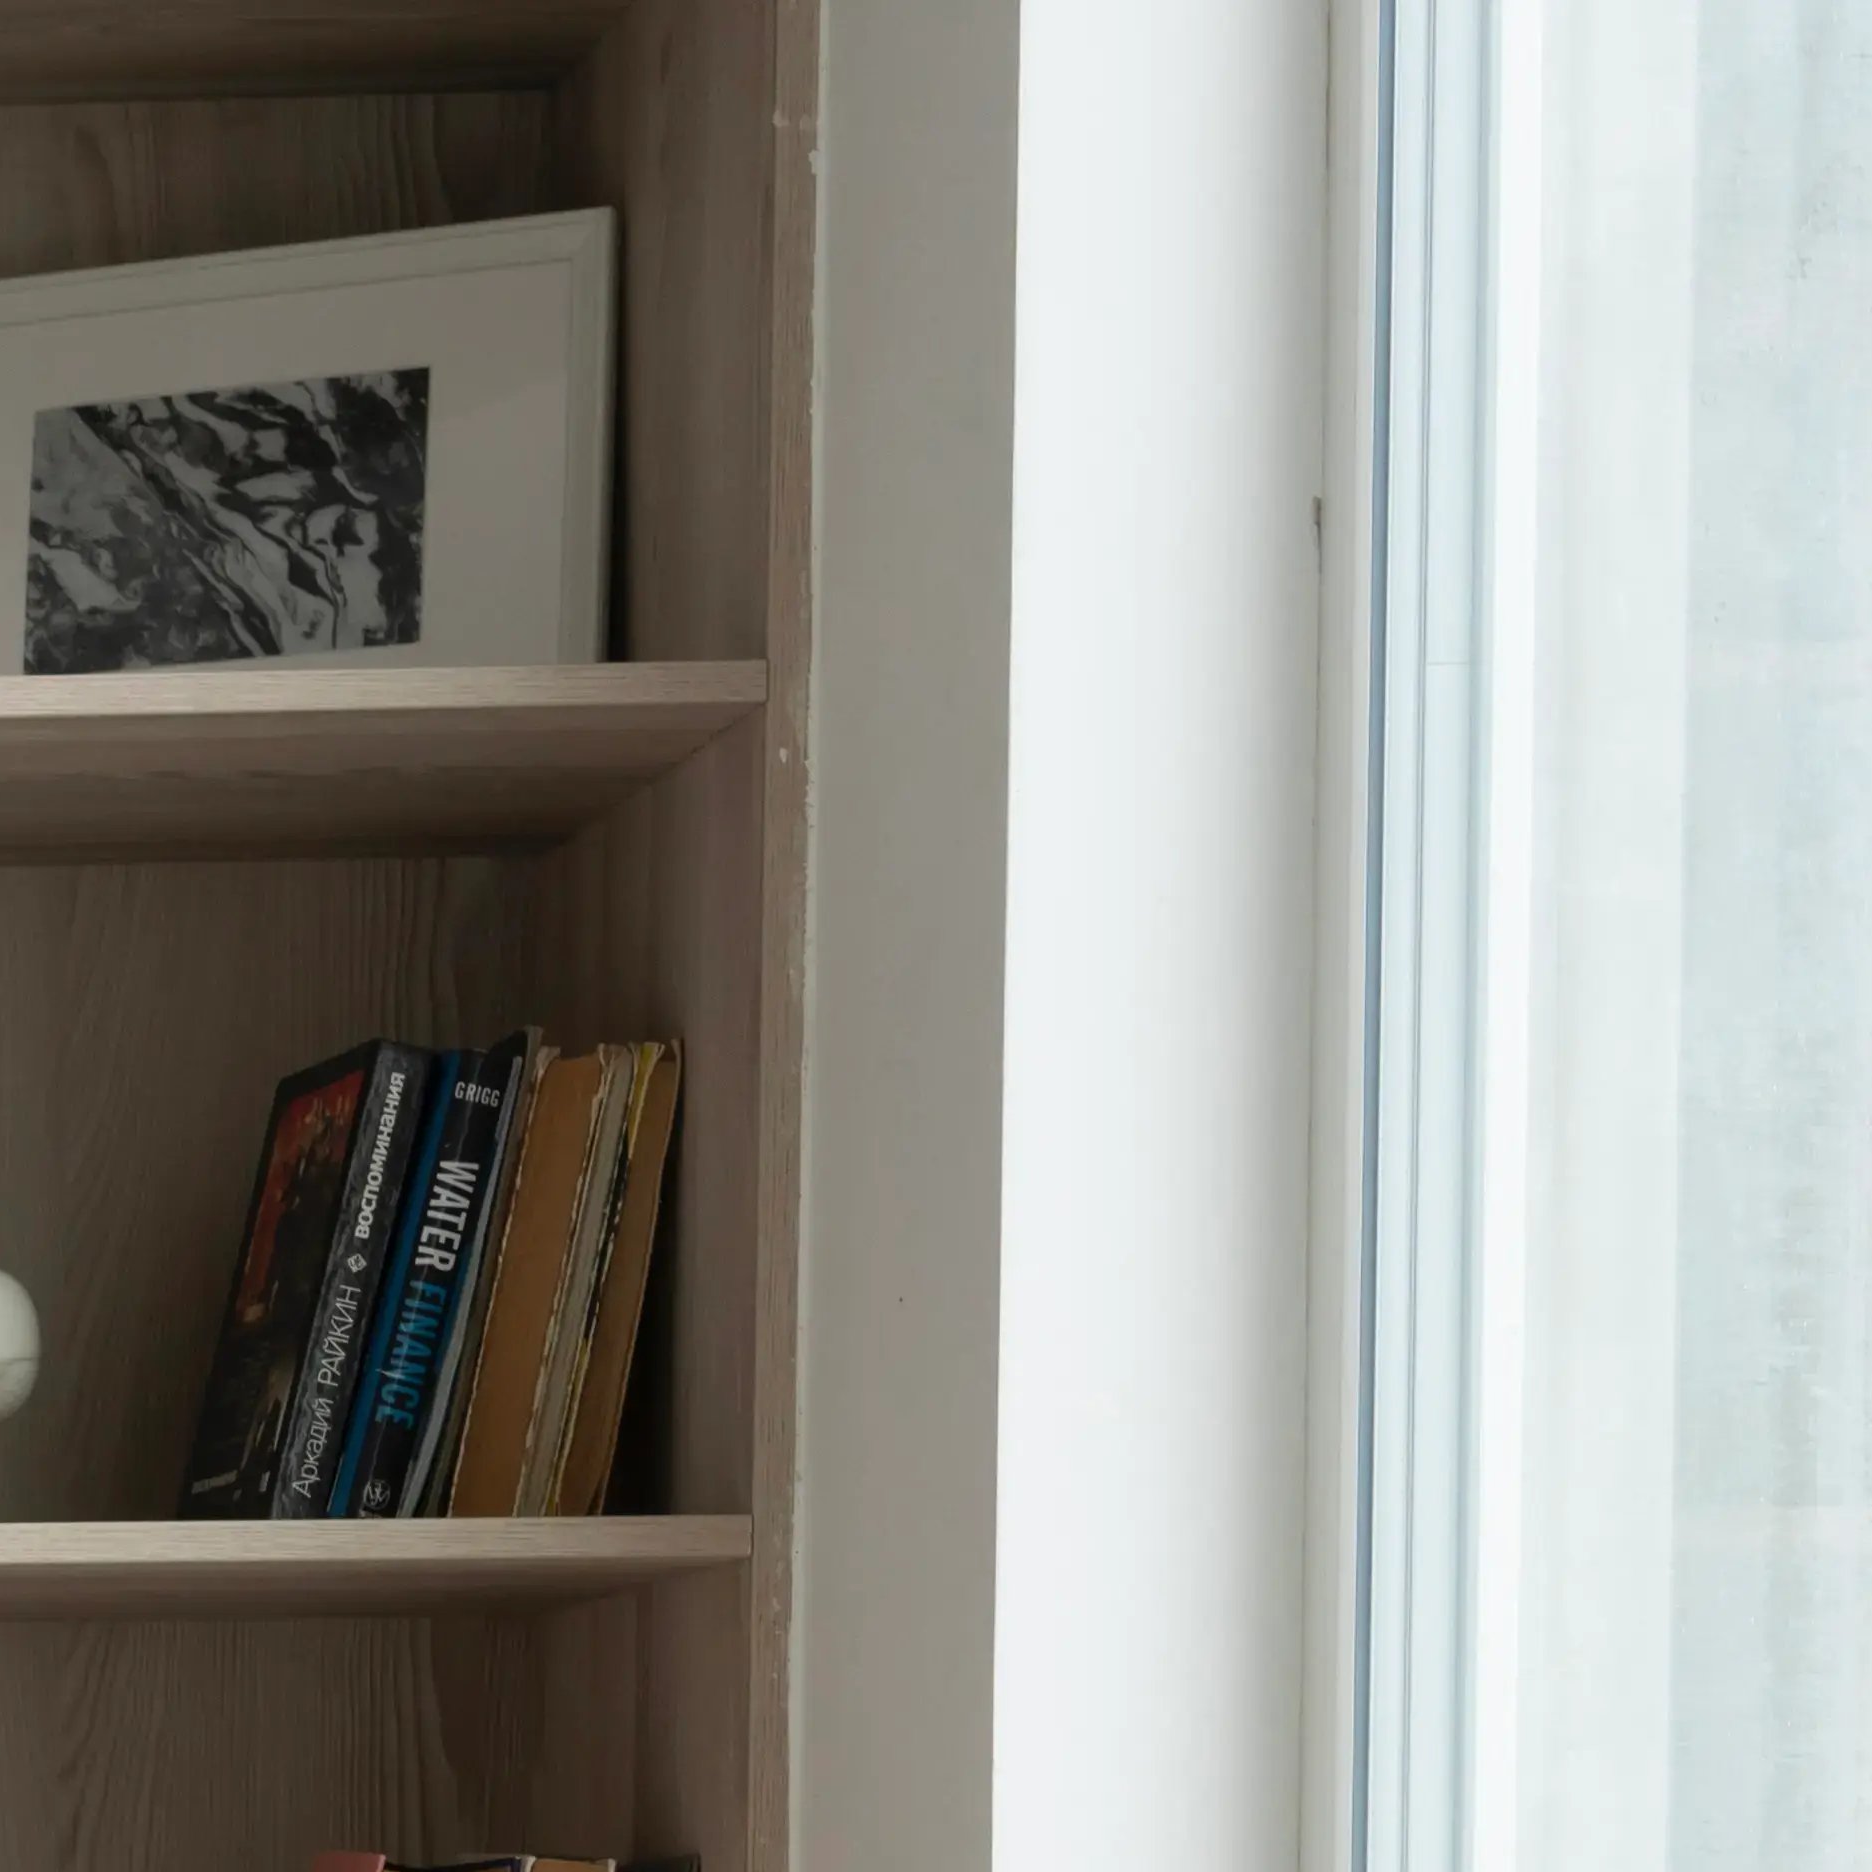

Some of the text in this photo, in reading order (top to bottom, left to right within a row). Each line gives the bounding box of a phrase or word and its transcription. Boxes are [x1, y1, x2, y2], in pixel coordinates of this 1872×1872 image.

[454, 1081, 500, 1107] GRIGG
[292, 1284, 362, 1498] Аркадий РАЙКИН
[375, 1160, 479, 1430] WATER FINANCE
